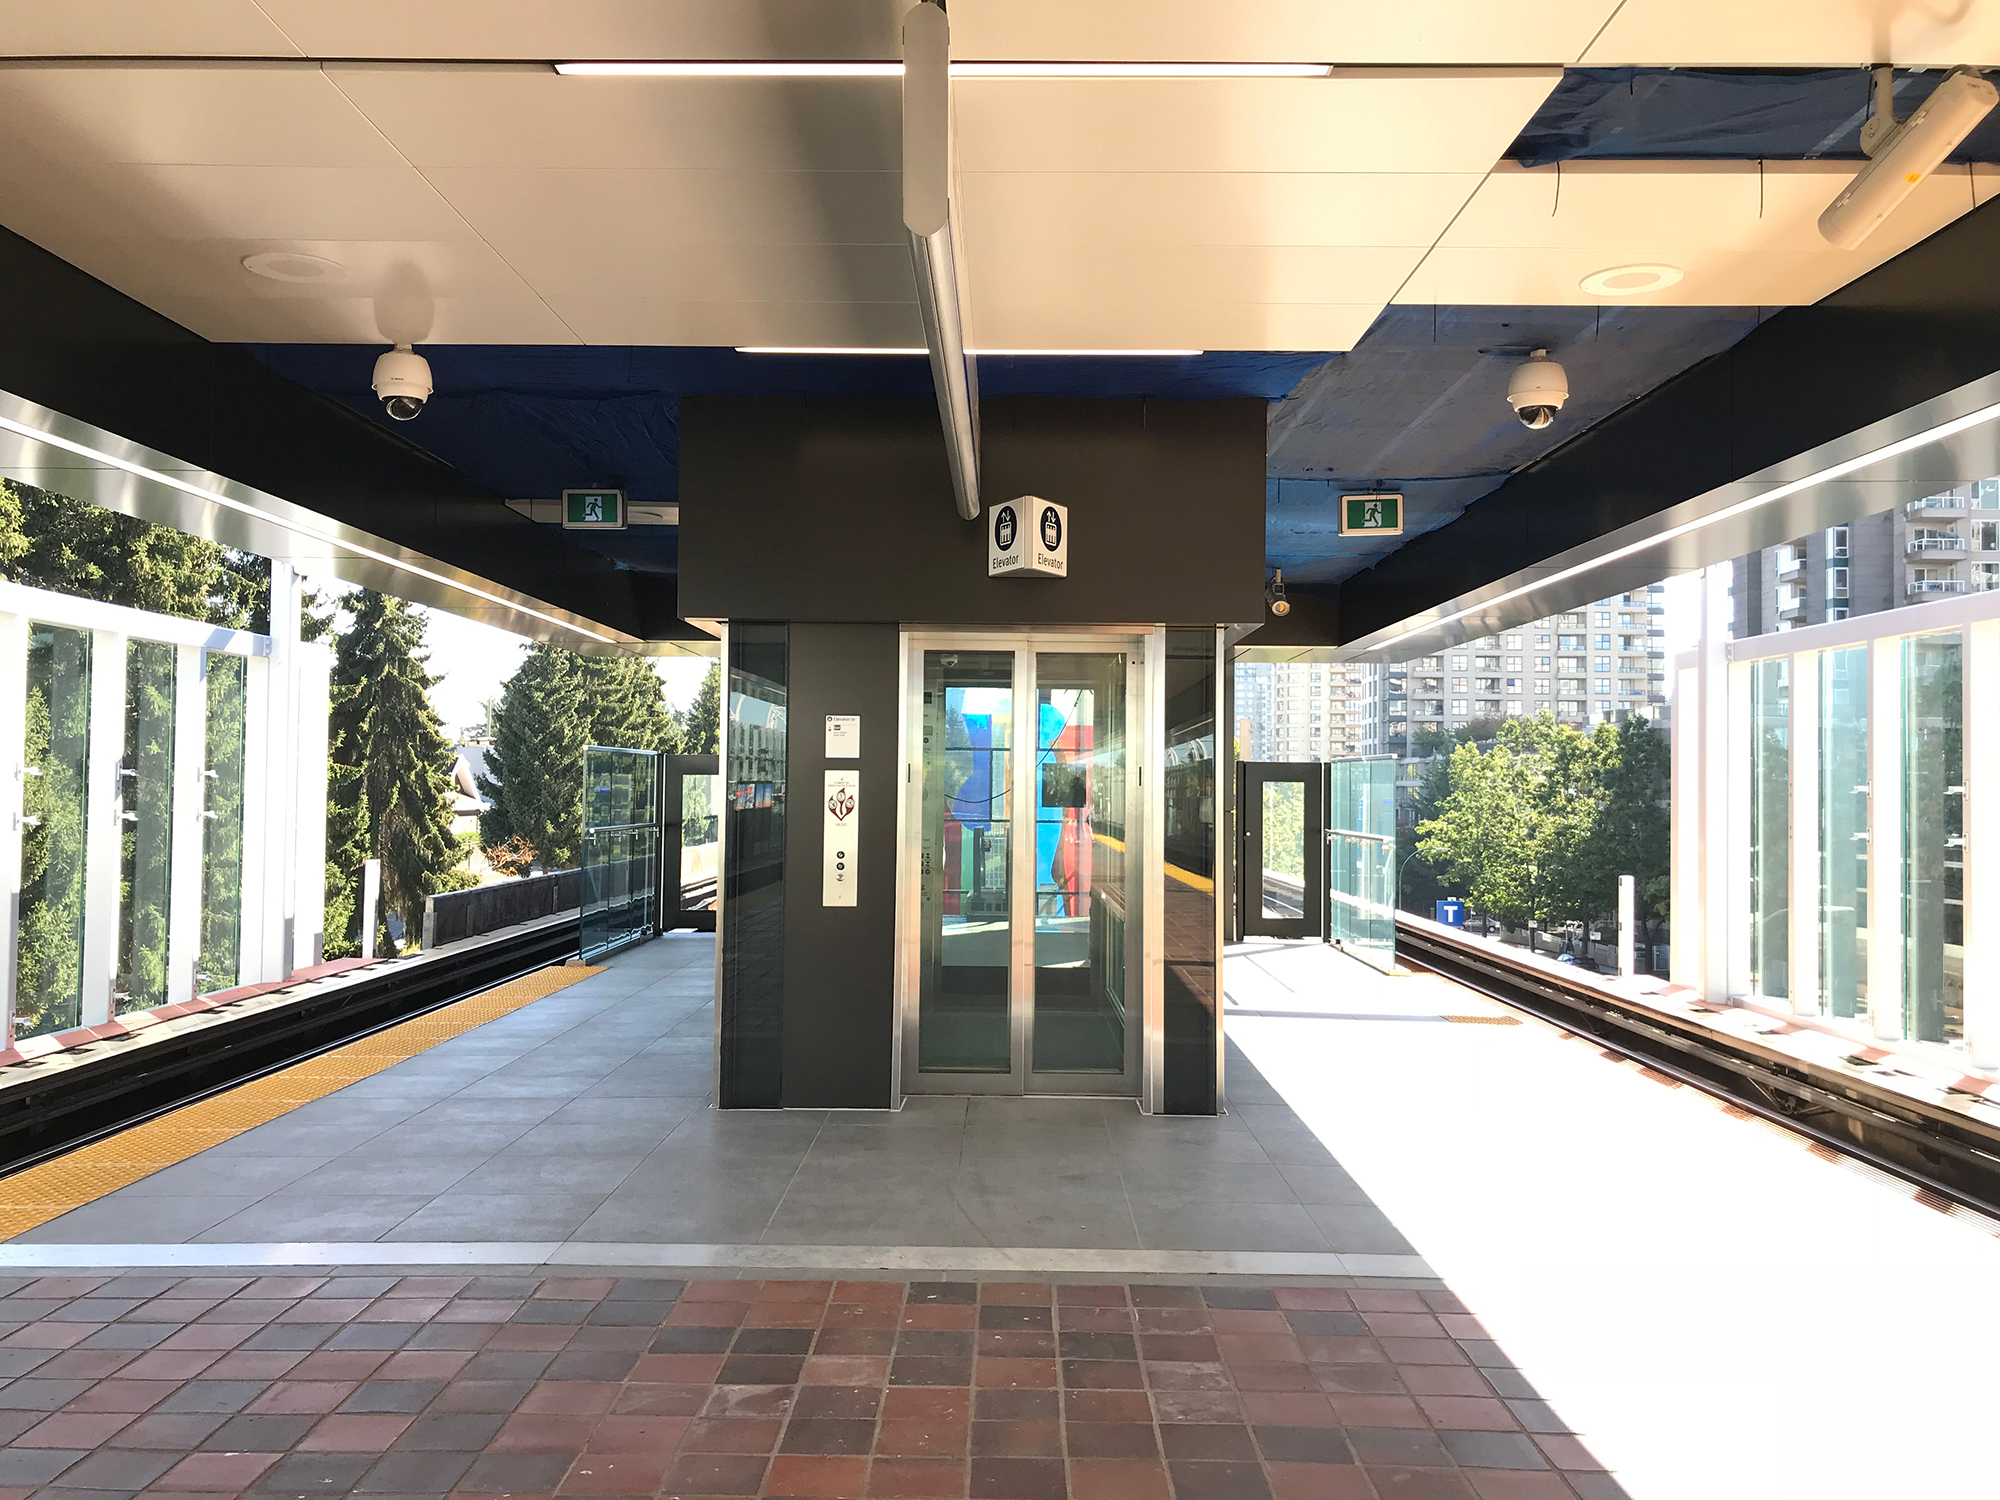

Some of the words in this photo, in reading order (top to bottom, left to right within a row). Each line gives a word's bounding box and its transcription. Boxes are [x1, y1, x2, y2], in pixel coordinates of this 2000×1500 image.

[992, 554, 1020, 569] Elevator
[1037, 552, 1064, 570] Elevator
[1443, 905, 1459, 923] T
